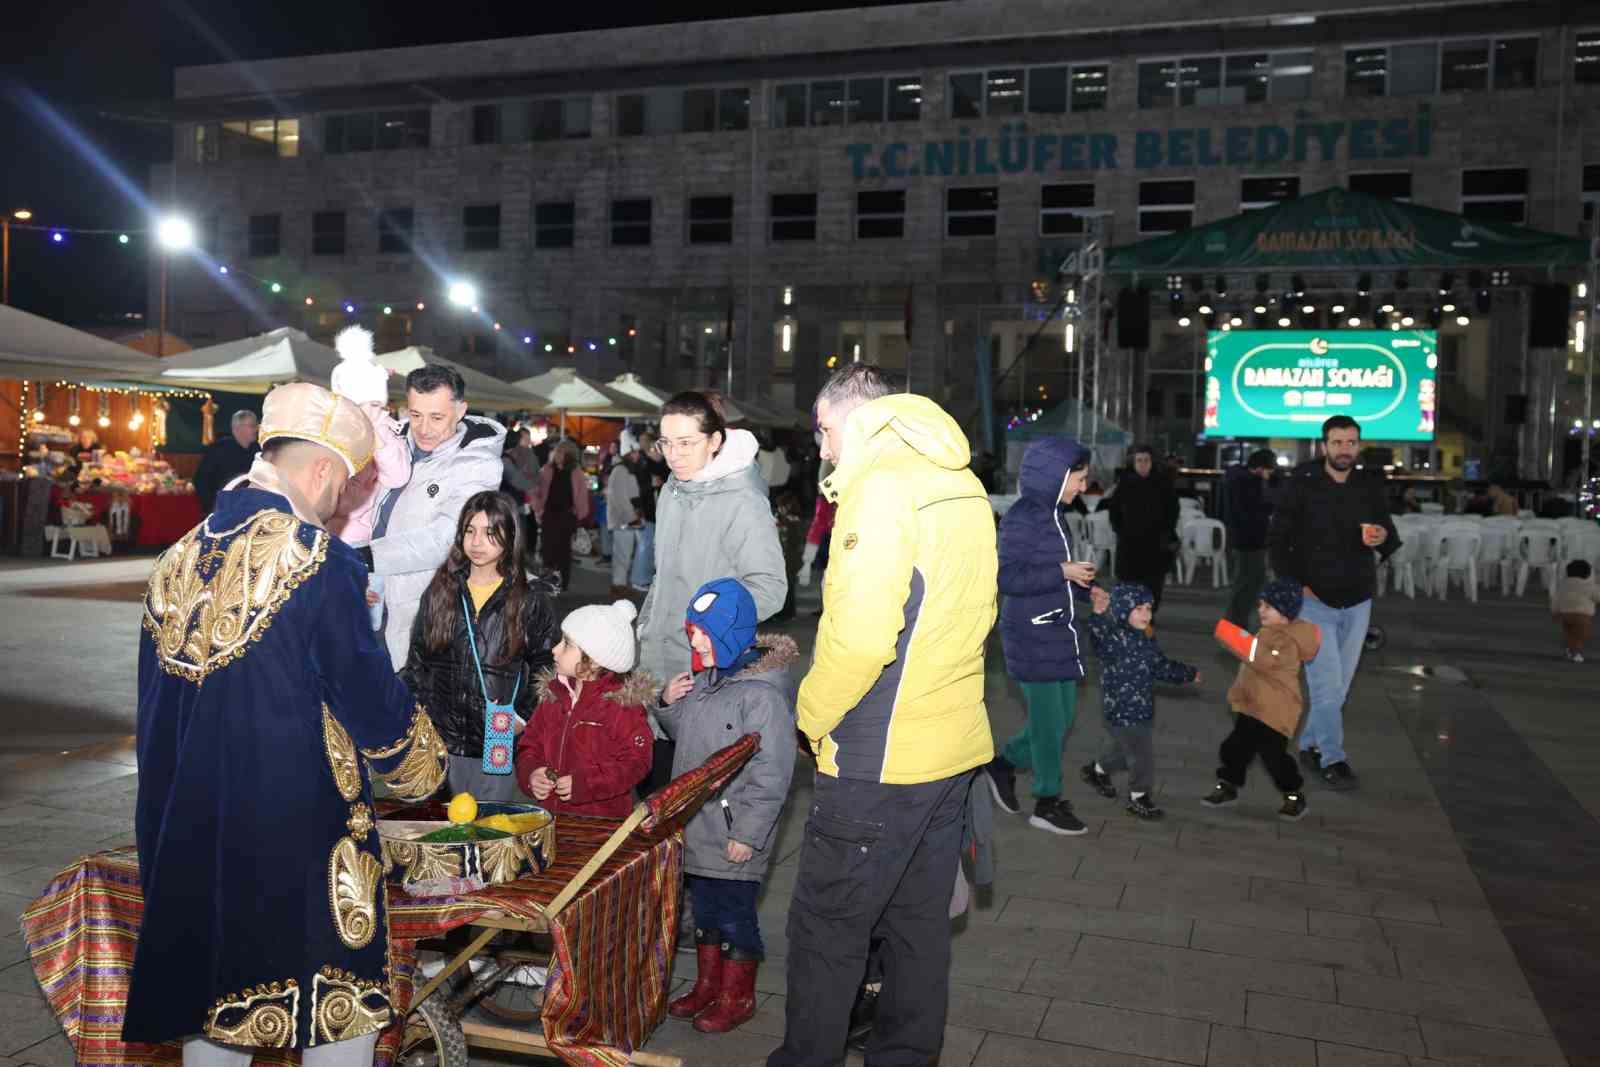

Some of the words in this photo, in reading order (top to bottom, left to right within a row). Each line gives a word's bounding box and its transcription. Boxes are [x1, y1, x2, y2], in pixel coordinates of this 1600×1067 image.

[1136, 103, 1432, 168] BELEDİYESİ
[1244, 368, 1323, 387] RAMAZAN
[1327, 365, 1393, 388] SOKAĞI
